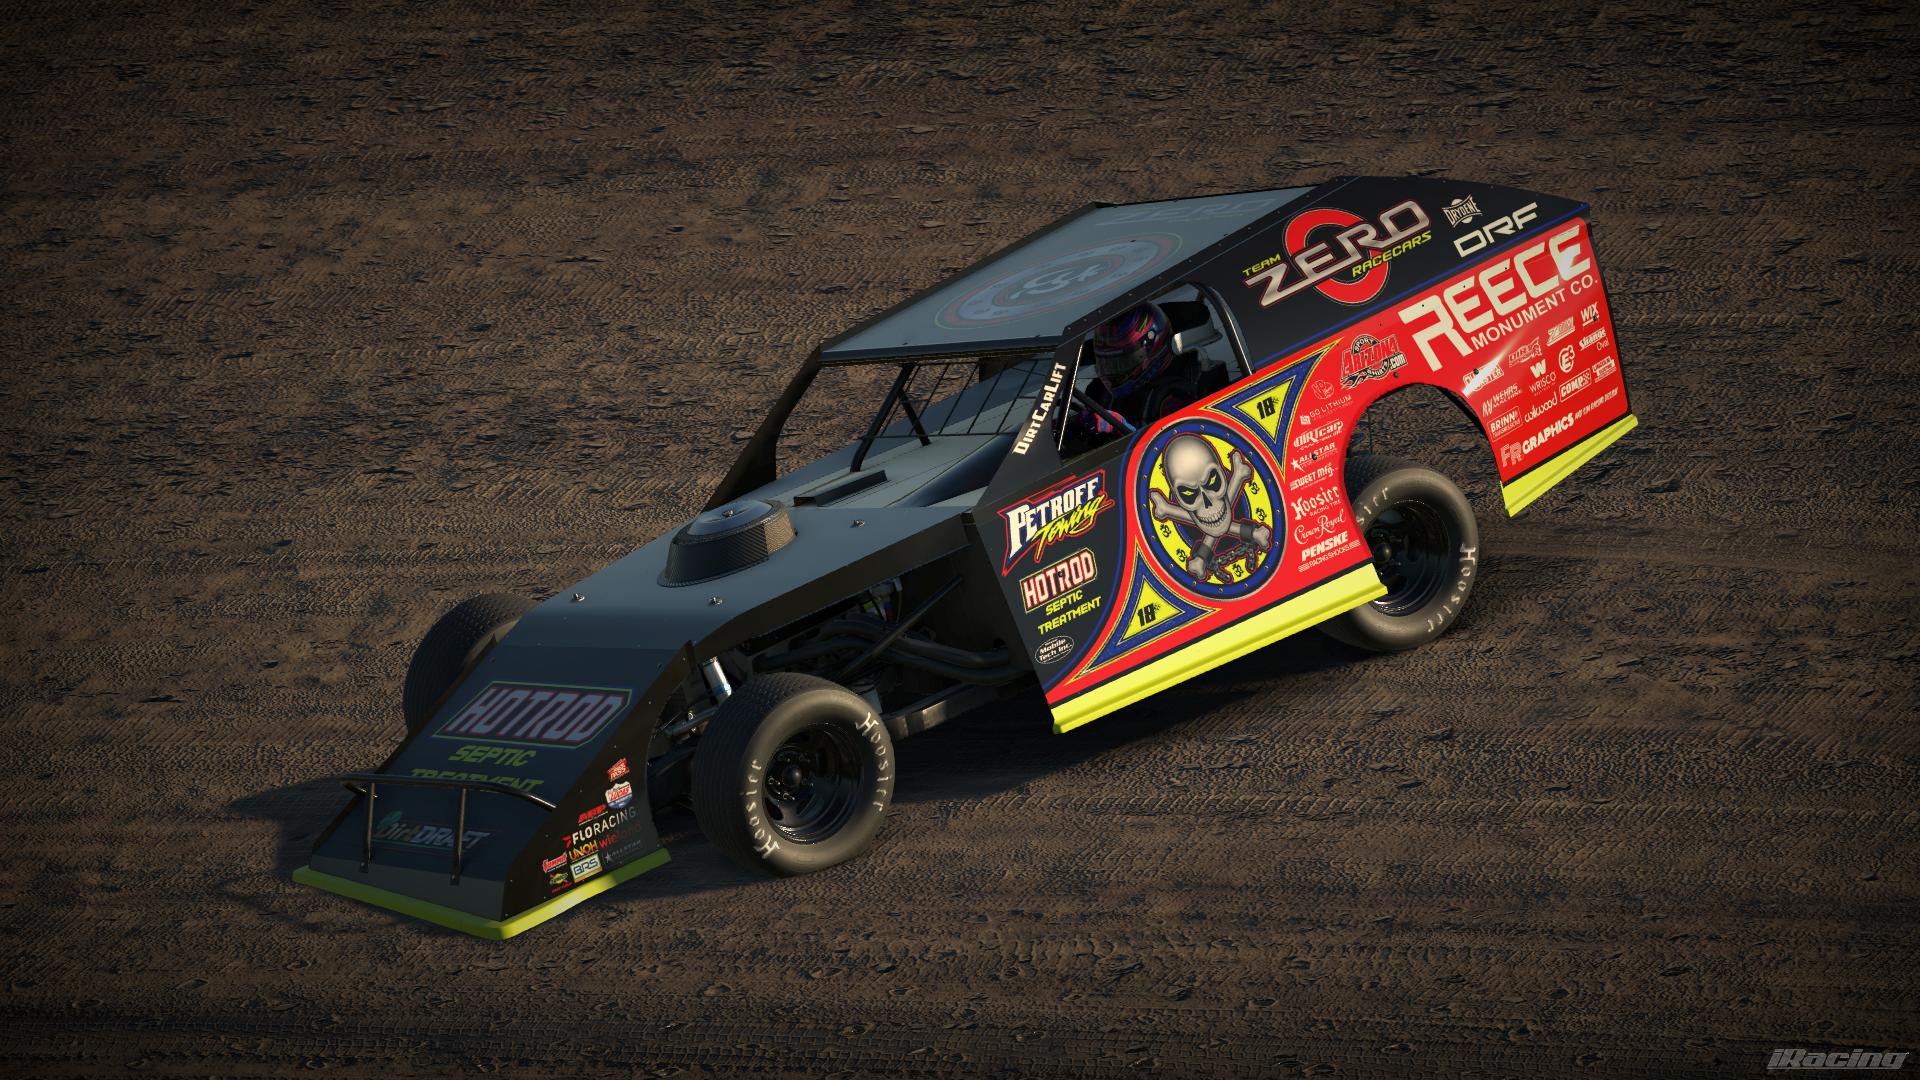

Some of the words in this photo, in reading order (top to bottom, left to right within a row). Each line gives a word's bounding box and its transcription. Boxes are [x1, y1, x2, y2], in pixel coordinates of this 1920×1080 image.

[1443, 195, 1481, 226] DRYDENE
[1453, 202, 1538, 258] DRF
[1242, 253, 1281, 276] TEAM
[1244, 200, 1431, 308] ZERO
[1352, 230, 1432, 278] RACECARS
[1397, 225, 1591, 373] REECE
[1470, 288, 1566, 350] MONUMENT
[1570, 274, 1599, 295] CO.
[1581, 302, 1600, 322] WIX
[1343, 336, 1399, 375] ARIZONA
[1529, 372, 1557, 393] WRISCO
[1322, 394, 1352, 414] LITHIUM
[1490, 412, 1515, 432] BRINN
[1522, 412, 1575, 454] GRAPHICS
[1299, 442, 1336, 463] ALLSTAR
[1294, 471, 1316, 488] SWEET
[1006, 476, 1099, 559] PETROFF
[1291, 486, 1340, 521] Hoosier
[1310, 504, 1329, 517] RACING
[1330, 499, 1342, 508] TIRE
[1031, 494, 1114, 560] Towing
[1294, 525, 1320, 545] Crown
[1316, 508, 1345, 539] Royal
[1301, 531, 1349, 562] PENSKE
[1021, 552, 1096, 610] HOTROD
[1428, 543, 1477, 633] Hoosier
[1037, 596, 1102, 635] TREATMENT
[1045, 590, 1083, 616] SEPTIC
[1038, 649, 1057, 663] Tech
[1039, 637, 1066, 655] Mobile
[445, 686, 626, 742] HOTROD
[448, 744, 537, 767] SEPTIC
[855, 712, 890, 812] Hoosier
[572, 806, 637, 846] FLORACING
[746, 759, 781, 859] Hoosier
[569, 840, 599, 860] UNOH
[573, 857, 600, 876] BRS
